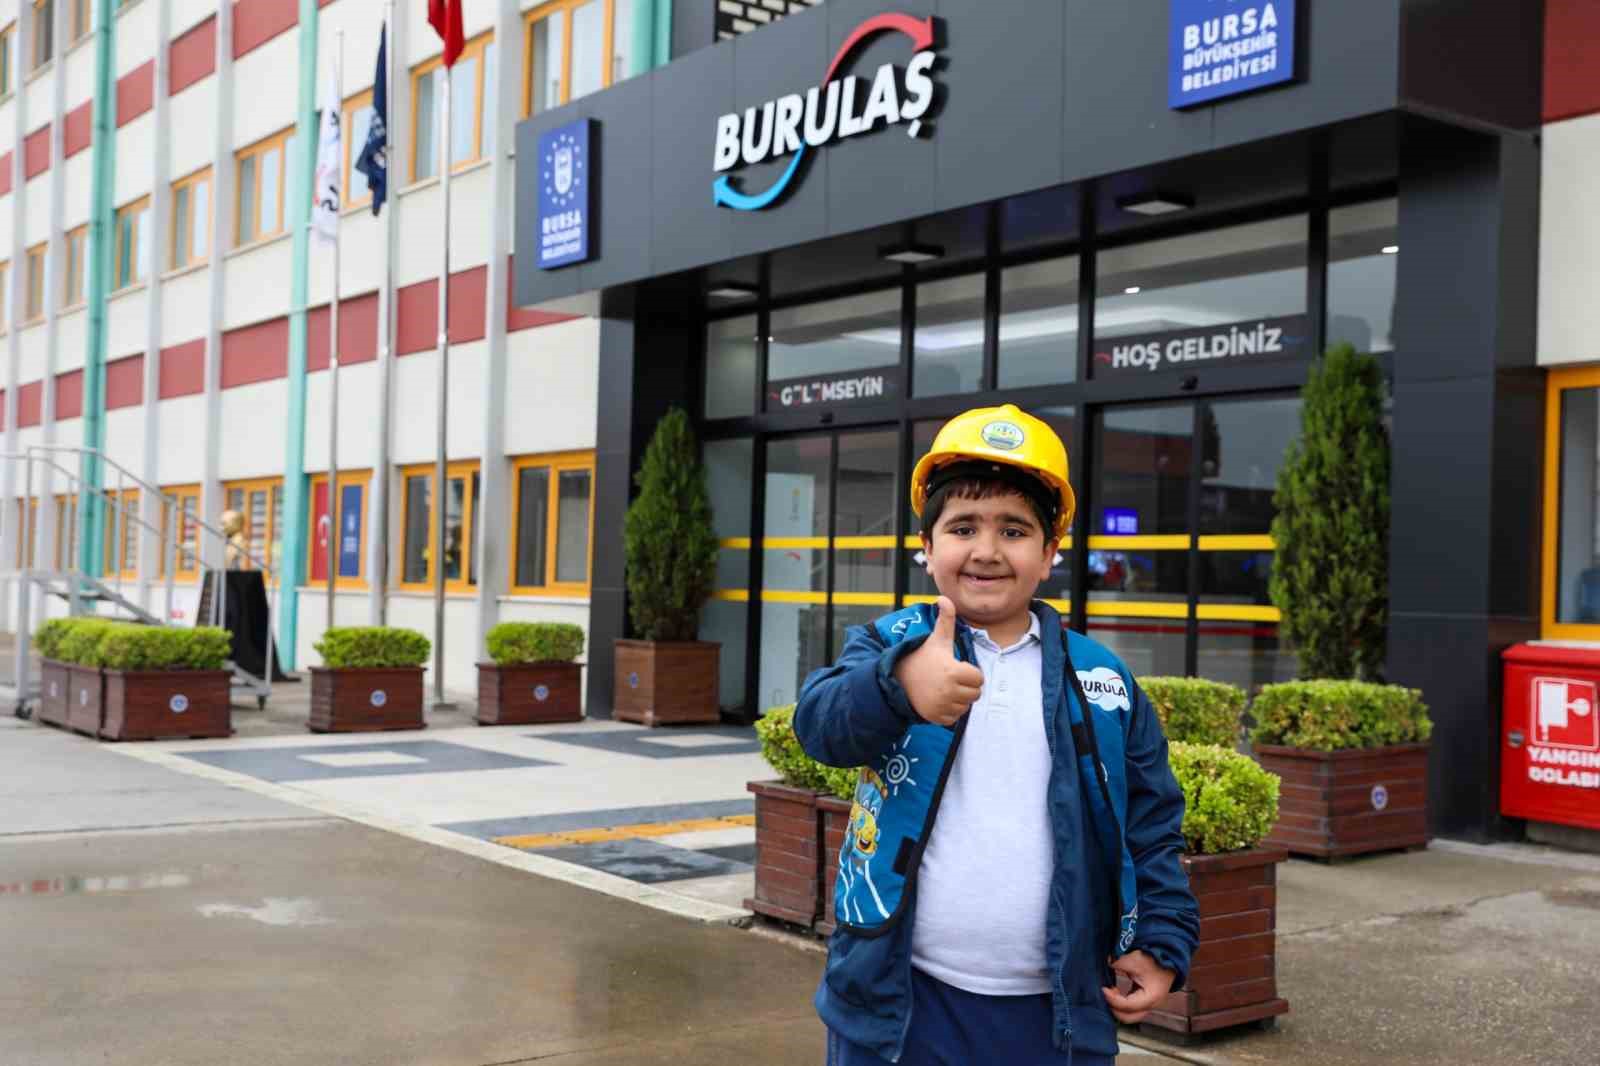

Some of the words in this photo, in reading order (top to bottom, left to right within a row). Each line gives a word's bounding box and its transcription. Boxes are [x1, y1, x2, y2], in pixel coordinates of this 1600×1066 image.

[1183, 3, 1278, 50] BURSA
[1181, 48, 1277, 92] BELEDİYESİ
[713, 51, 936, 172] BURULAŞ
[1112, 341, 1160, 371] HOŞ
[1166, 323, 1282, 362] GELDİNİZ
[1080, 680, 1126, 698] URULA
[1527, 745, 1600, 769] YANGIN
